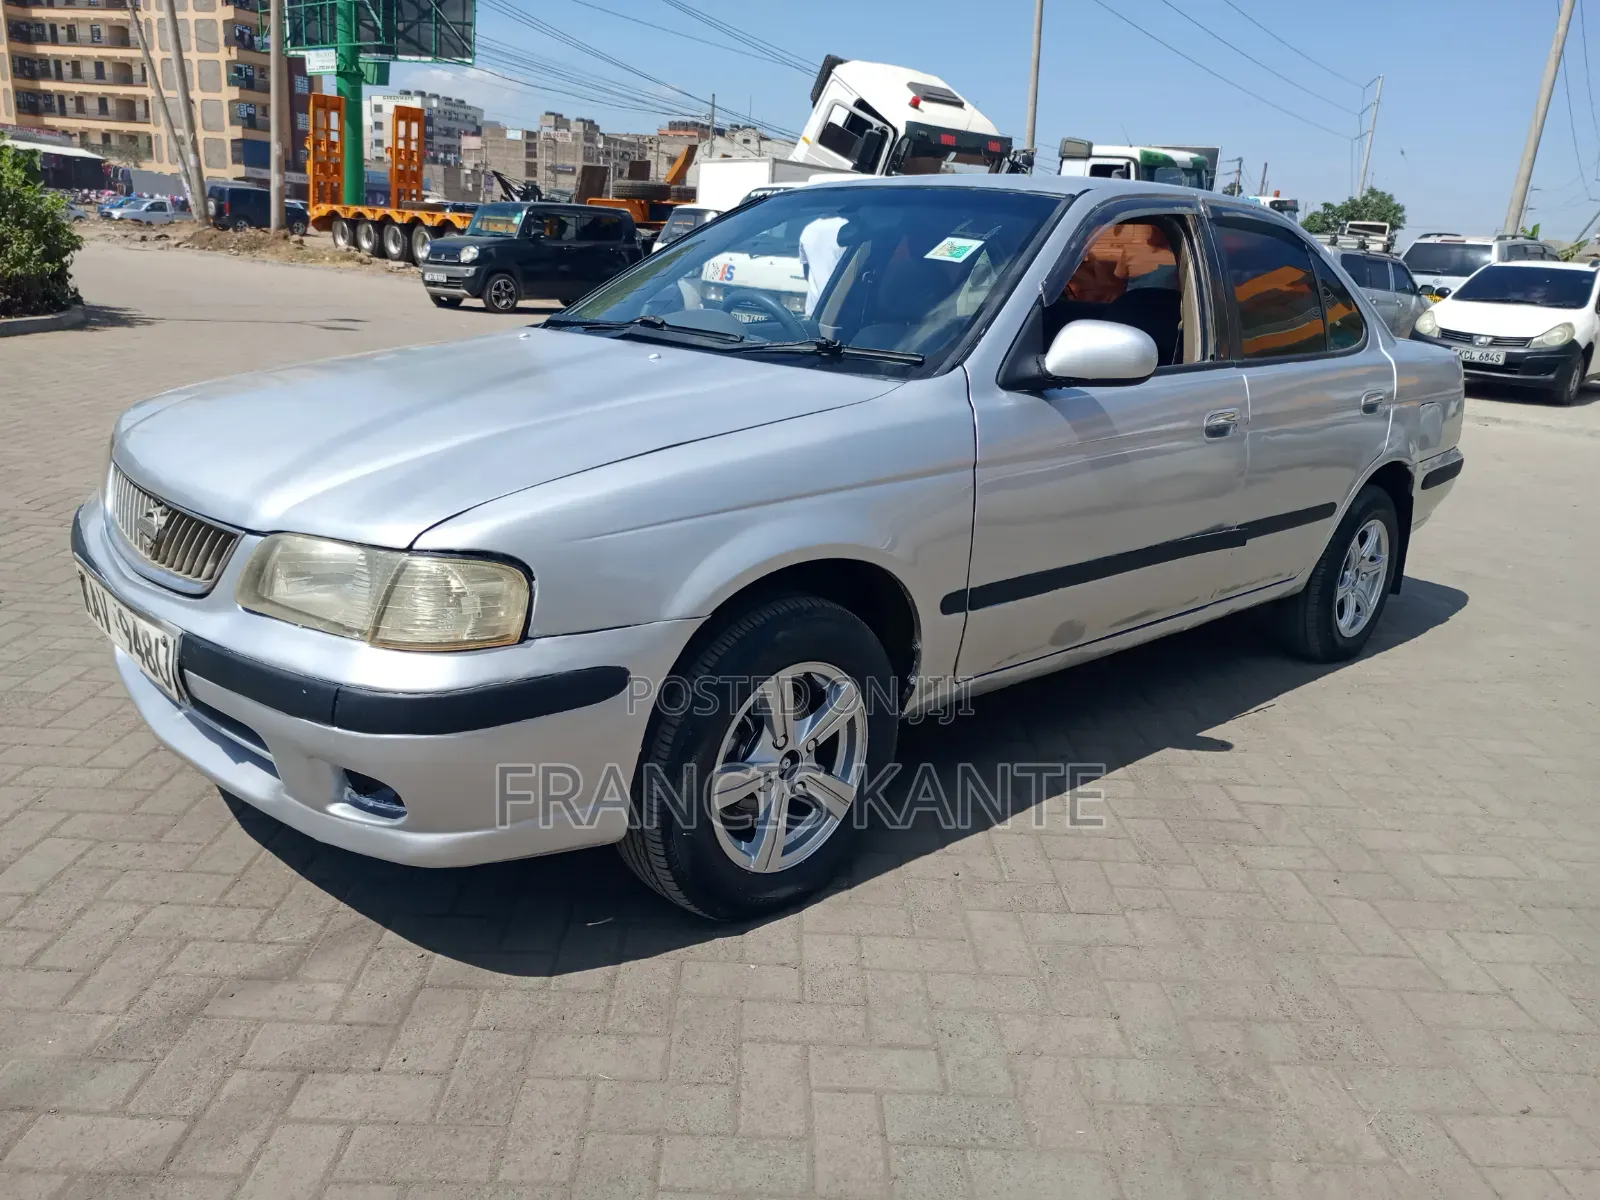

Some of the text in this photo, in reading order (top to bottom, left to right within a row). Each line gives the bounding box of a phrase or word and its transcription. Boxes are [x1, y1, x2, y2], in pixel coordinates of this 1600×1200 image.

[1459, 349, 1502, 363] KCL 684S
[116, 607, 173, 692] 948U
